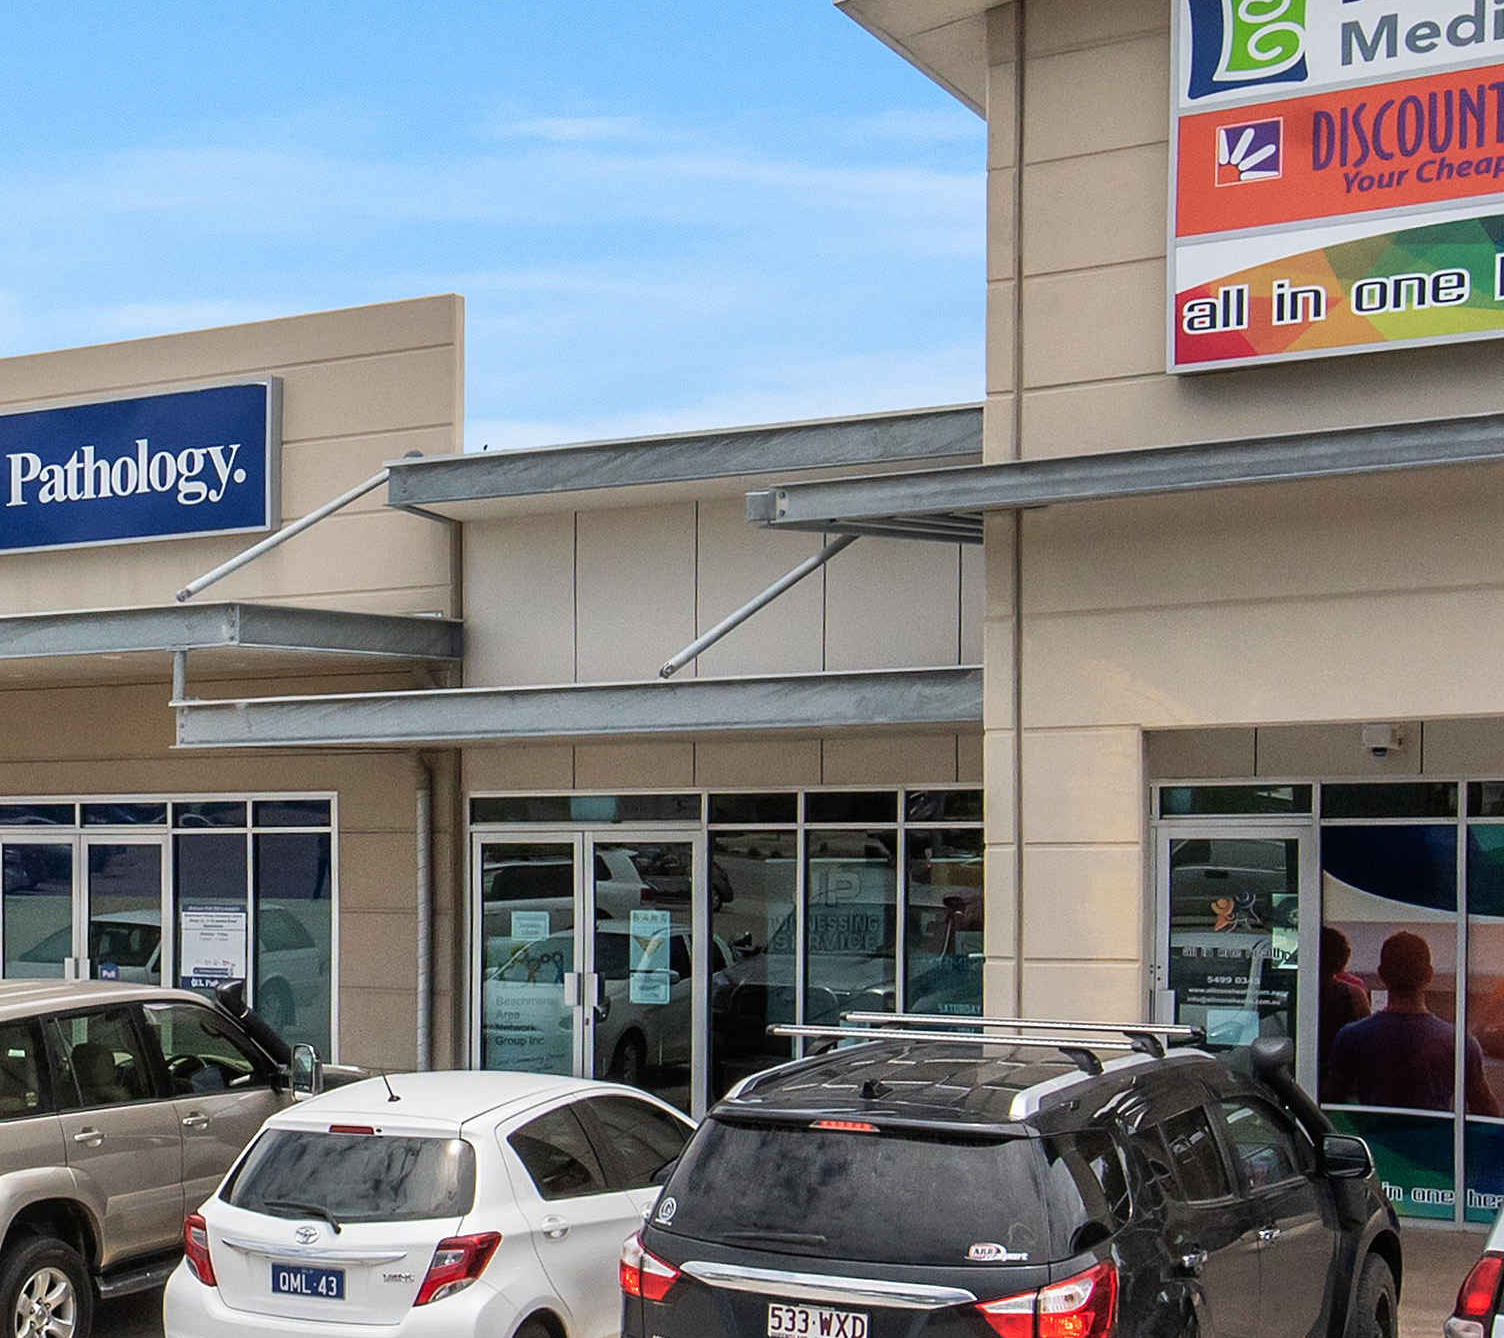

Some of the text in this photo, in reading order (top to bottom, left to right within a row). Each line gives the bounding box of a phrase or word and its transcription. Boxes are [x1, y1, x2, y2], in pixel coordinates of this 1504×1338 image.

[1343, 170, 1408, 195] Your
[1183, 283, 1250, 335] all
[1272, 278, 1328, 326] in
[1351, 268, 1471, 316] one
[6, 438, 247, 509] Pathology.
[1207, 976, 1233, 985] 5499
[495, 1010, 521, 1021] Area
[495, 1023, 538, 1032] Network
[495, 1035, 545, 1047] Group Inc
[1411, 1187, 1457, 1206] one
